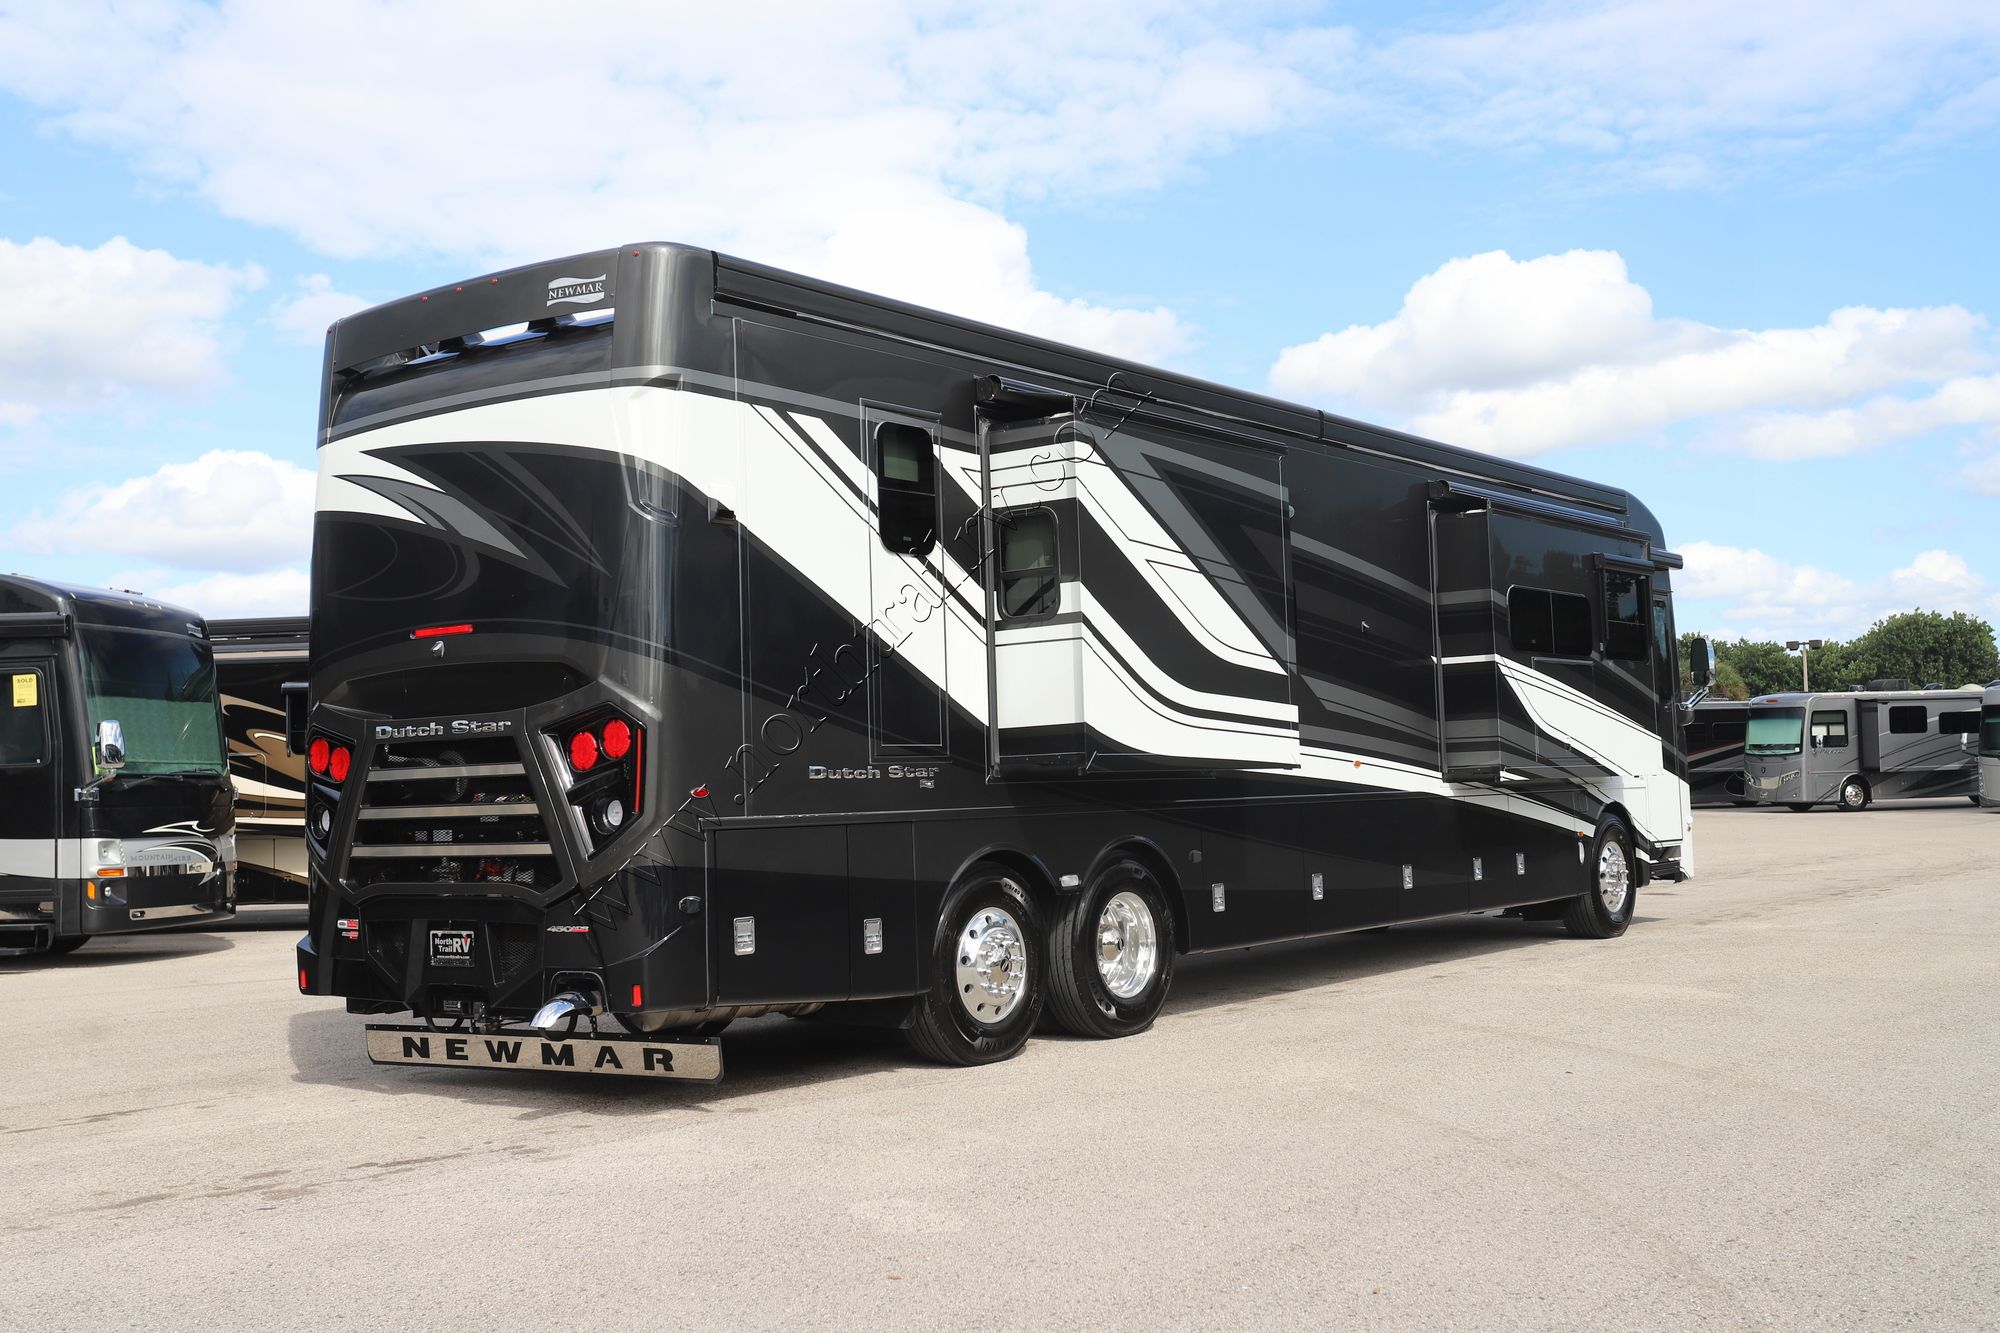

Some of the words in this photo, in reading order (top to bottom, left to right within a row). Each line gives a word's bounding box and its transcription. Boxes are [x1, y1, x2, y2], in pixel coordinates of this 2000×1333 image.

[548, 281, 605, 300] NEWMAR
[375, 721, 444, 739] Dutch
[451, 719, 512, 734] Star
[808, 765, 881, 779] Dutch
[888, 764, 940, 778] Star
[434, 937, 452, 945] North
[452, 938, 471, 953] RV
[402, 1036, 674, 1072] NEWMAR
